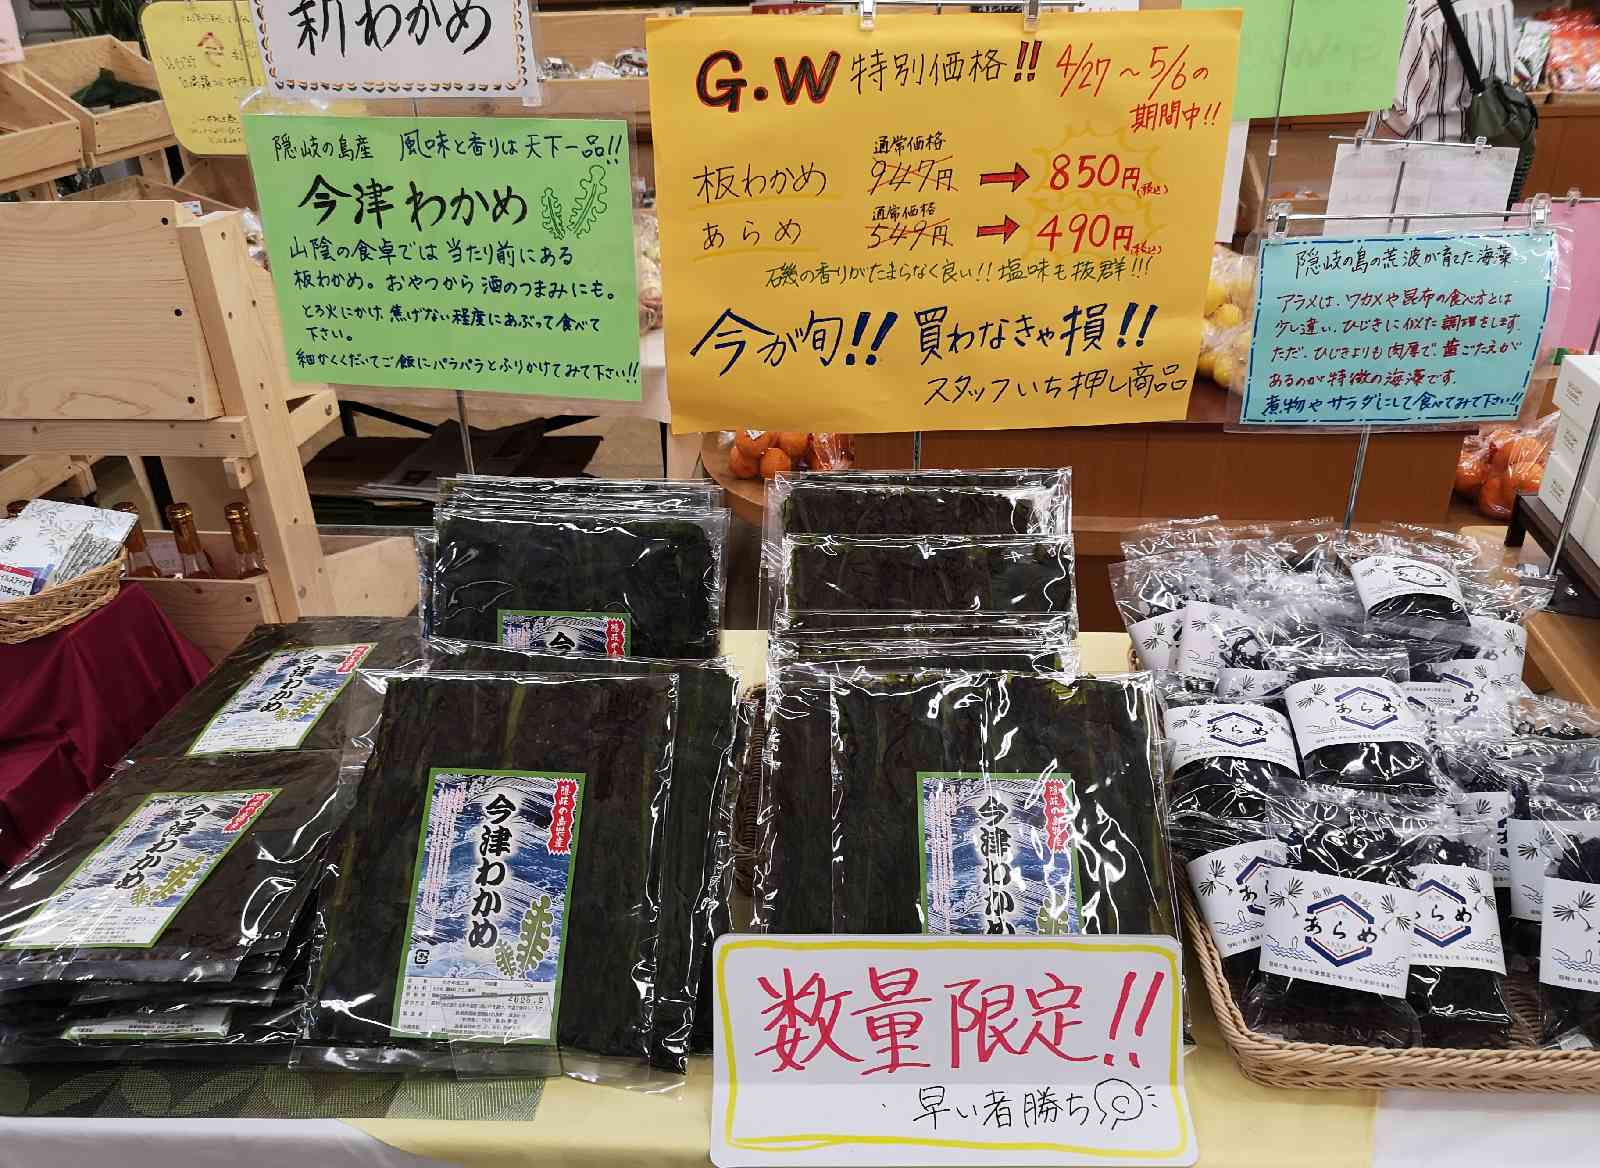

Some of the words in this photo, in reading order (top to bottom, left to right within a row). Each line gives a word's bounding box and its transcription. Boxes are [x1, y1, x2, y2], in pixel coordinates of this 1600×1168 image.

[696, 50, 841, 112] G.W
[1129, 101, 1222, 133] 期間中!!
[271, 133, 374, 161] 隠岐の島産
[872, 131, 946, 155] 通常価格
[692, 161, 827, 204] 板わかめ
[298, 174, 528, 231] 今津わかめ
[872, 202, 936, 221] 通常価格
[702, 218, 802, 250] あらめ
[305, 326, 353, 344] 下さい。
[690, 306, 899, 376] 今が旬!!
[913, 302, 1158, 367] 買わなきゃ損!!
[924, 360, 1188, 405] スタッフいち押し商品
[1336, 702, 1398, 714] あらめ
[468, 794, 517, 949] 今津わかめ
[1304, 916, 1378, 943] あらめ
[754, 967, 1166, 1075] 数量限定!!
[912, 1085, 1090, 1130] 早い者勝ち
